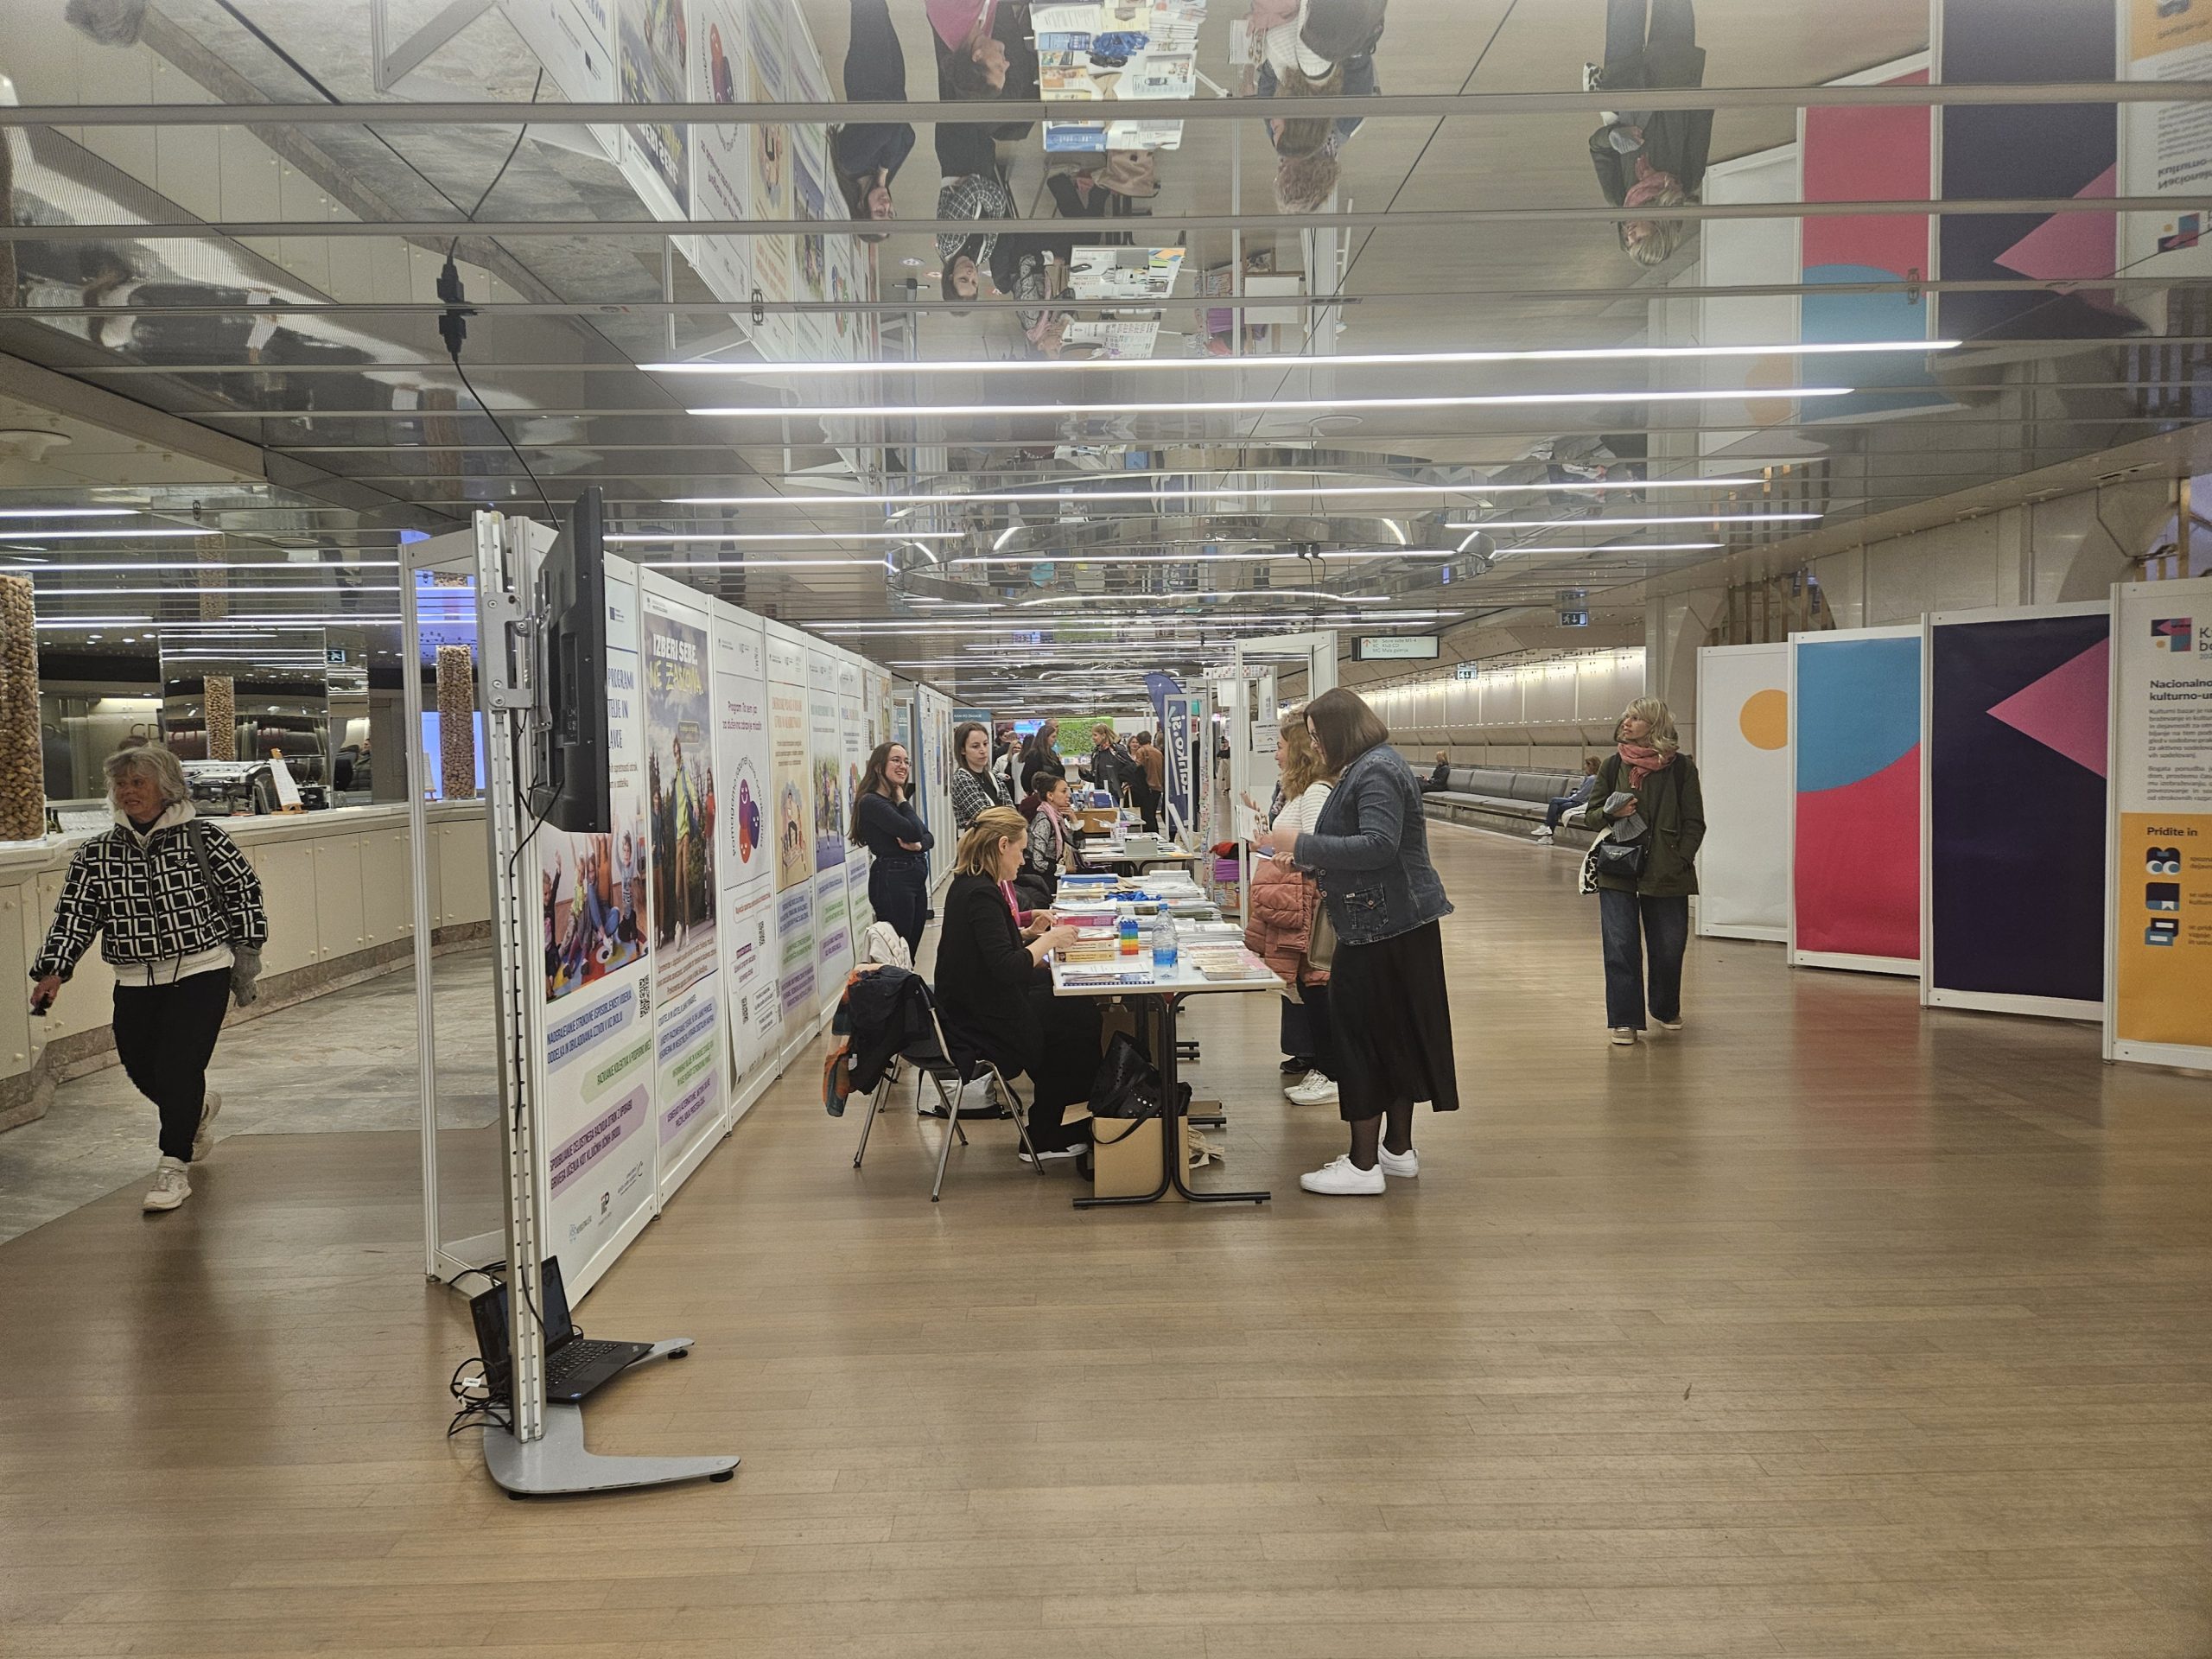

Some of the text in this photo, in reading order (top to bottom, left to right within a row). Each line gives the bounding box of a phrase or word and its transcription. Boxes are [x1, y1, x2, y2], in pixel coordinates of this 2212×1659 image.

[2199, 626, 2212, 639] K
[653, 633, 677, 661] IZBERI
[622, 700, 628, 720] IN
[2146, 827, 2198, 836] Pridite in
